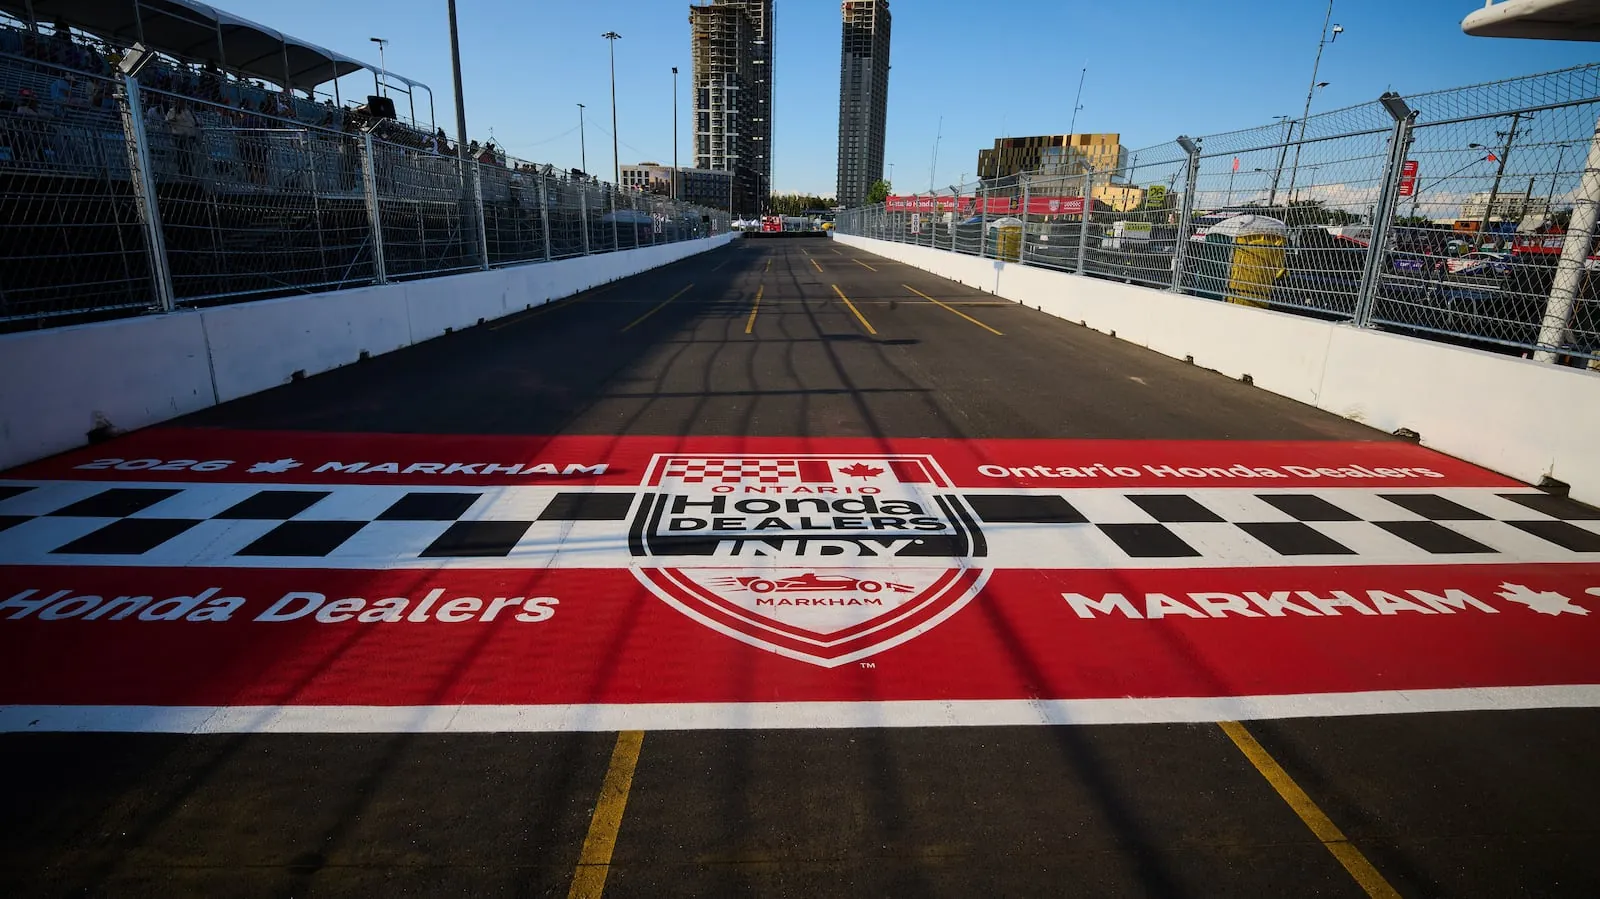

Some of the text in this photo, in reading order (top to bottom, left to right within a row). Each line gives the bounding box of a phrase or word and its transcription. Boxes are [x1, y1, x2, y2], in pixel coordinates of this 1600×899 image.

[72, 458, 610, 475] 2026 MARKHAM
[977, 463, 1445, 478] Ontario Honda Dealers
[711, 485, 881, 494] ONTARIO
[670, 495, 924, 514] Honda
[668, 516, 947, 531] DEALERS
[711, 539, 915, 556] INDY
[0, 587, 560, 624] Honda Dealers
[756, 598, 883, 606] MARKHAM
[1061, 589, 1500, 619] MARKHAM
